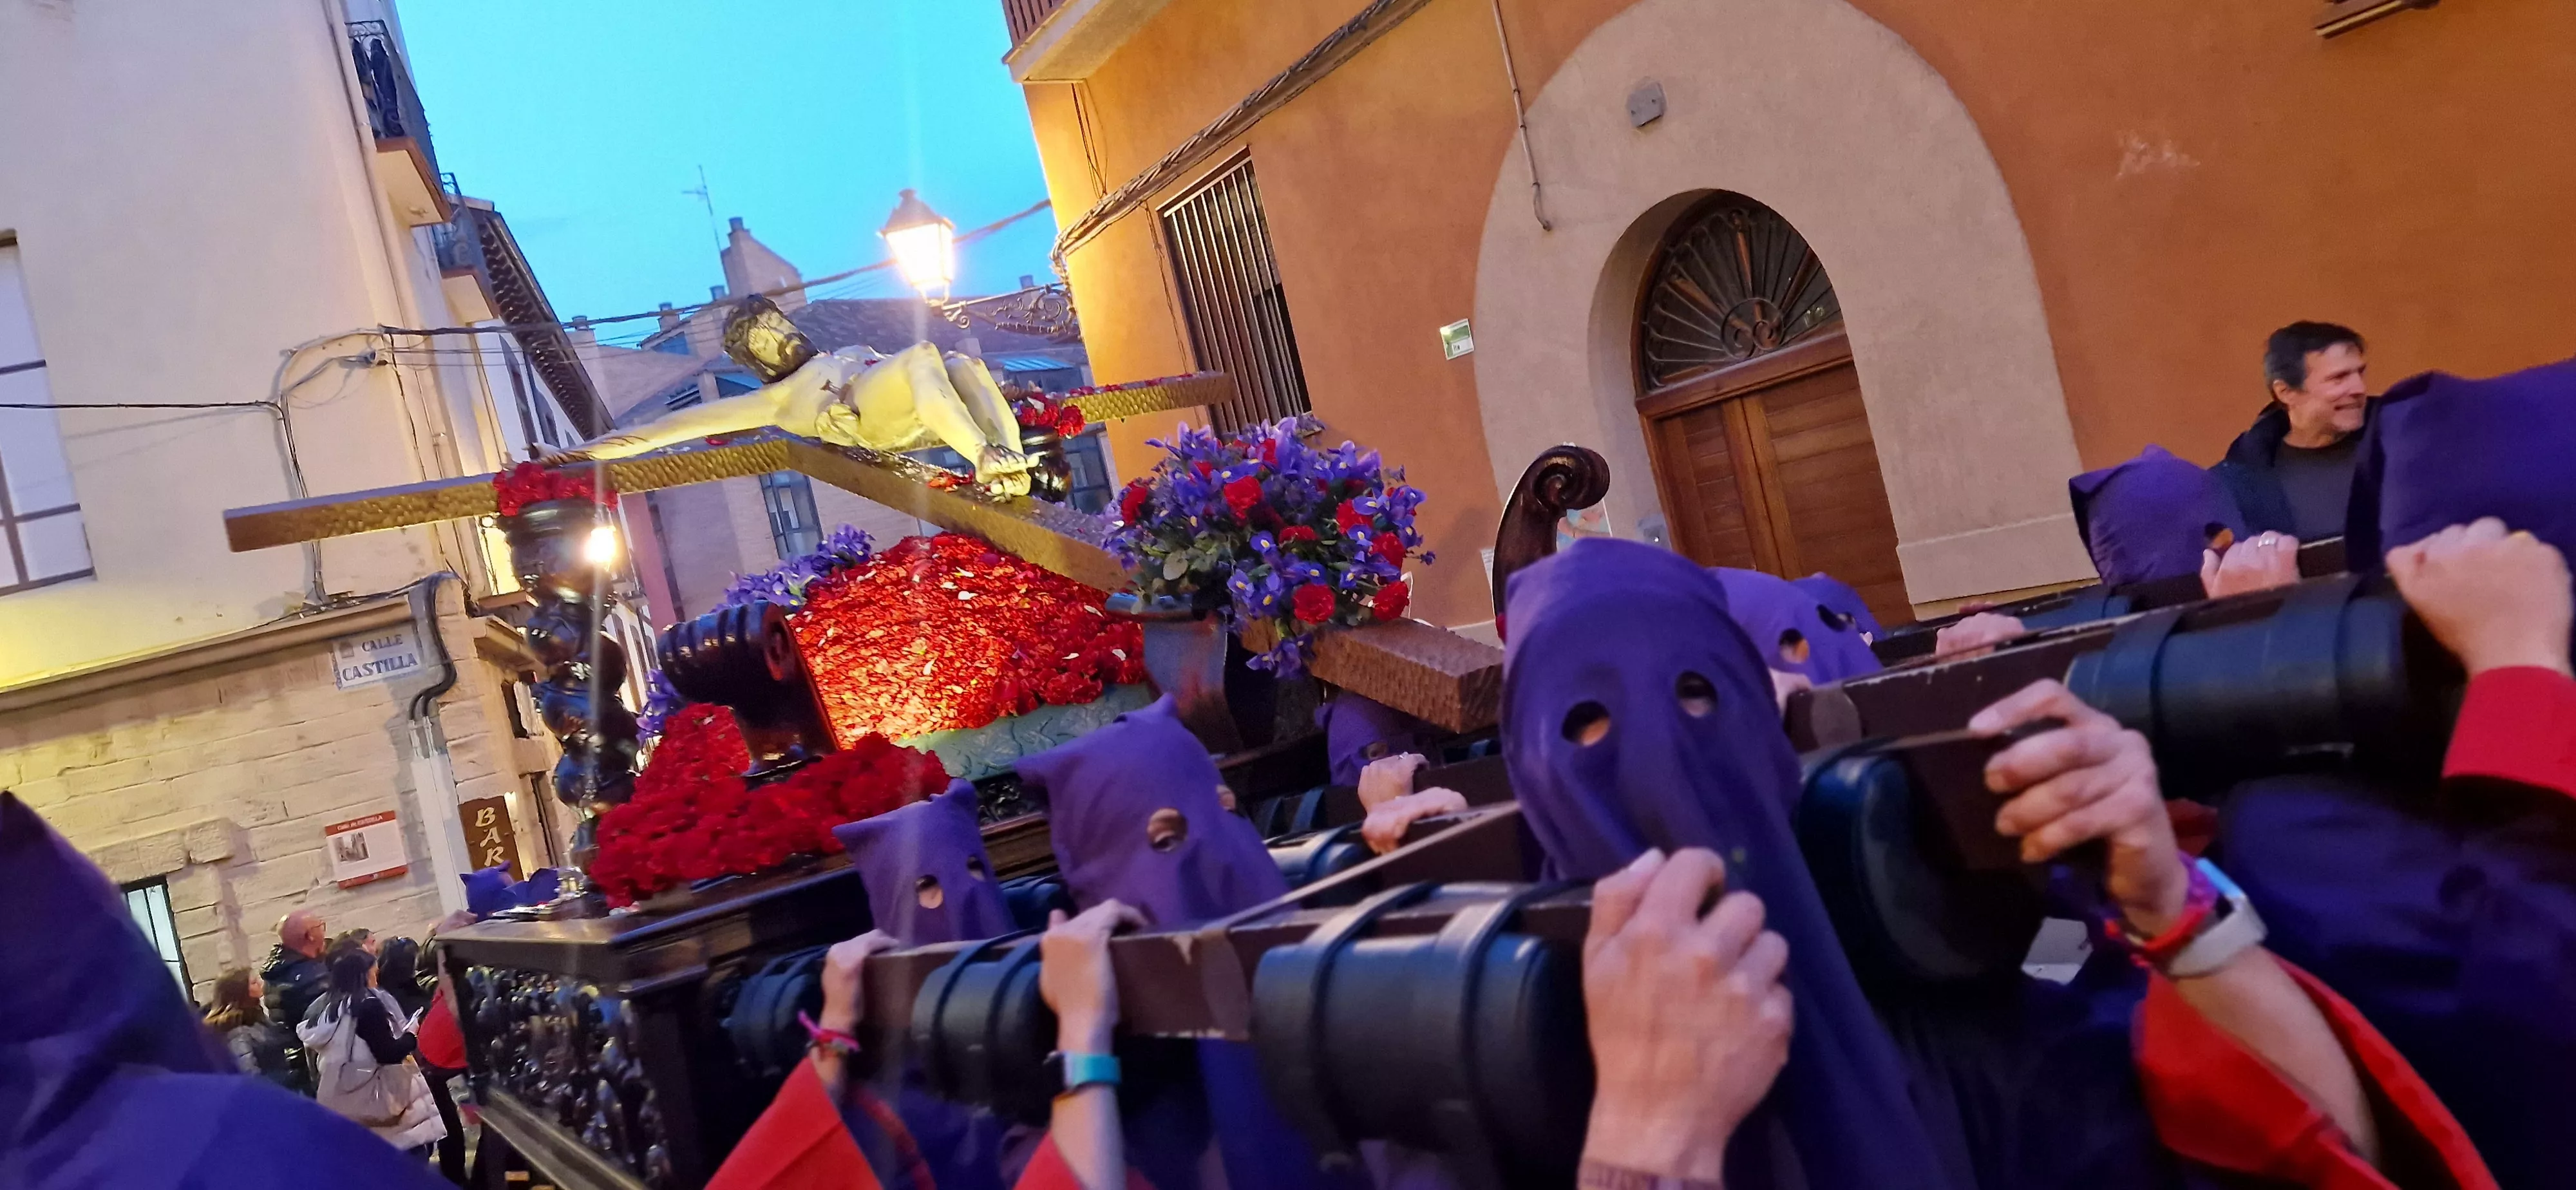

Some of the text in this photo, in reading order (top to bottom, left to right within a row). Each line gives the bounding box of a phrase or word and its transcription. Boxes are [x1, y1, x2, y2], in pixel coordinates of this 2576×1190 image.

[361, 634, 403, 652] CALLE
[342, 652, 418, 681] CASTILLA
[475, 807, 504, 867] BAR
